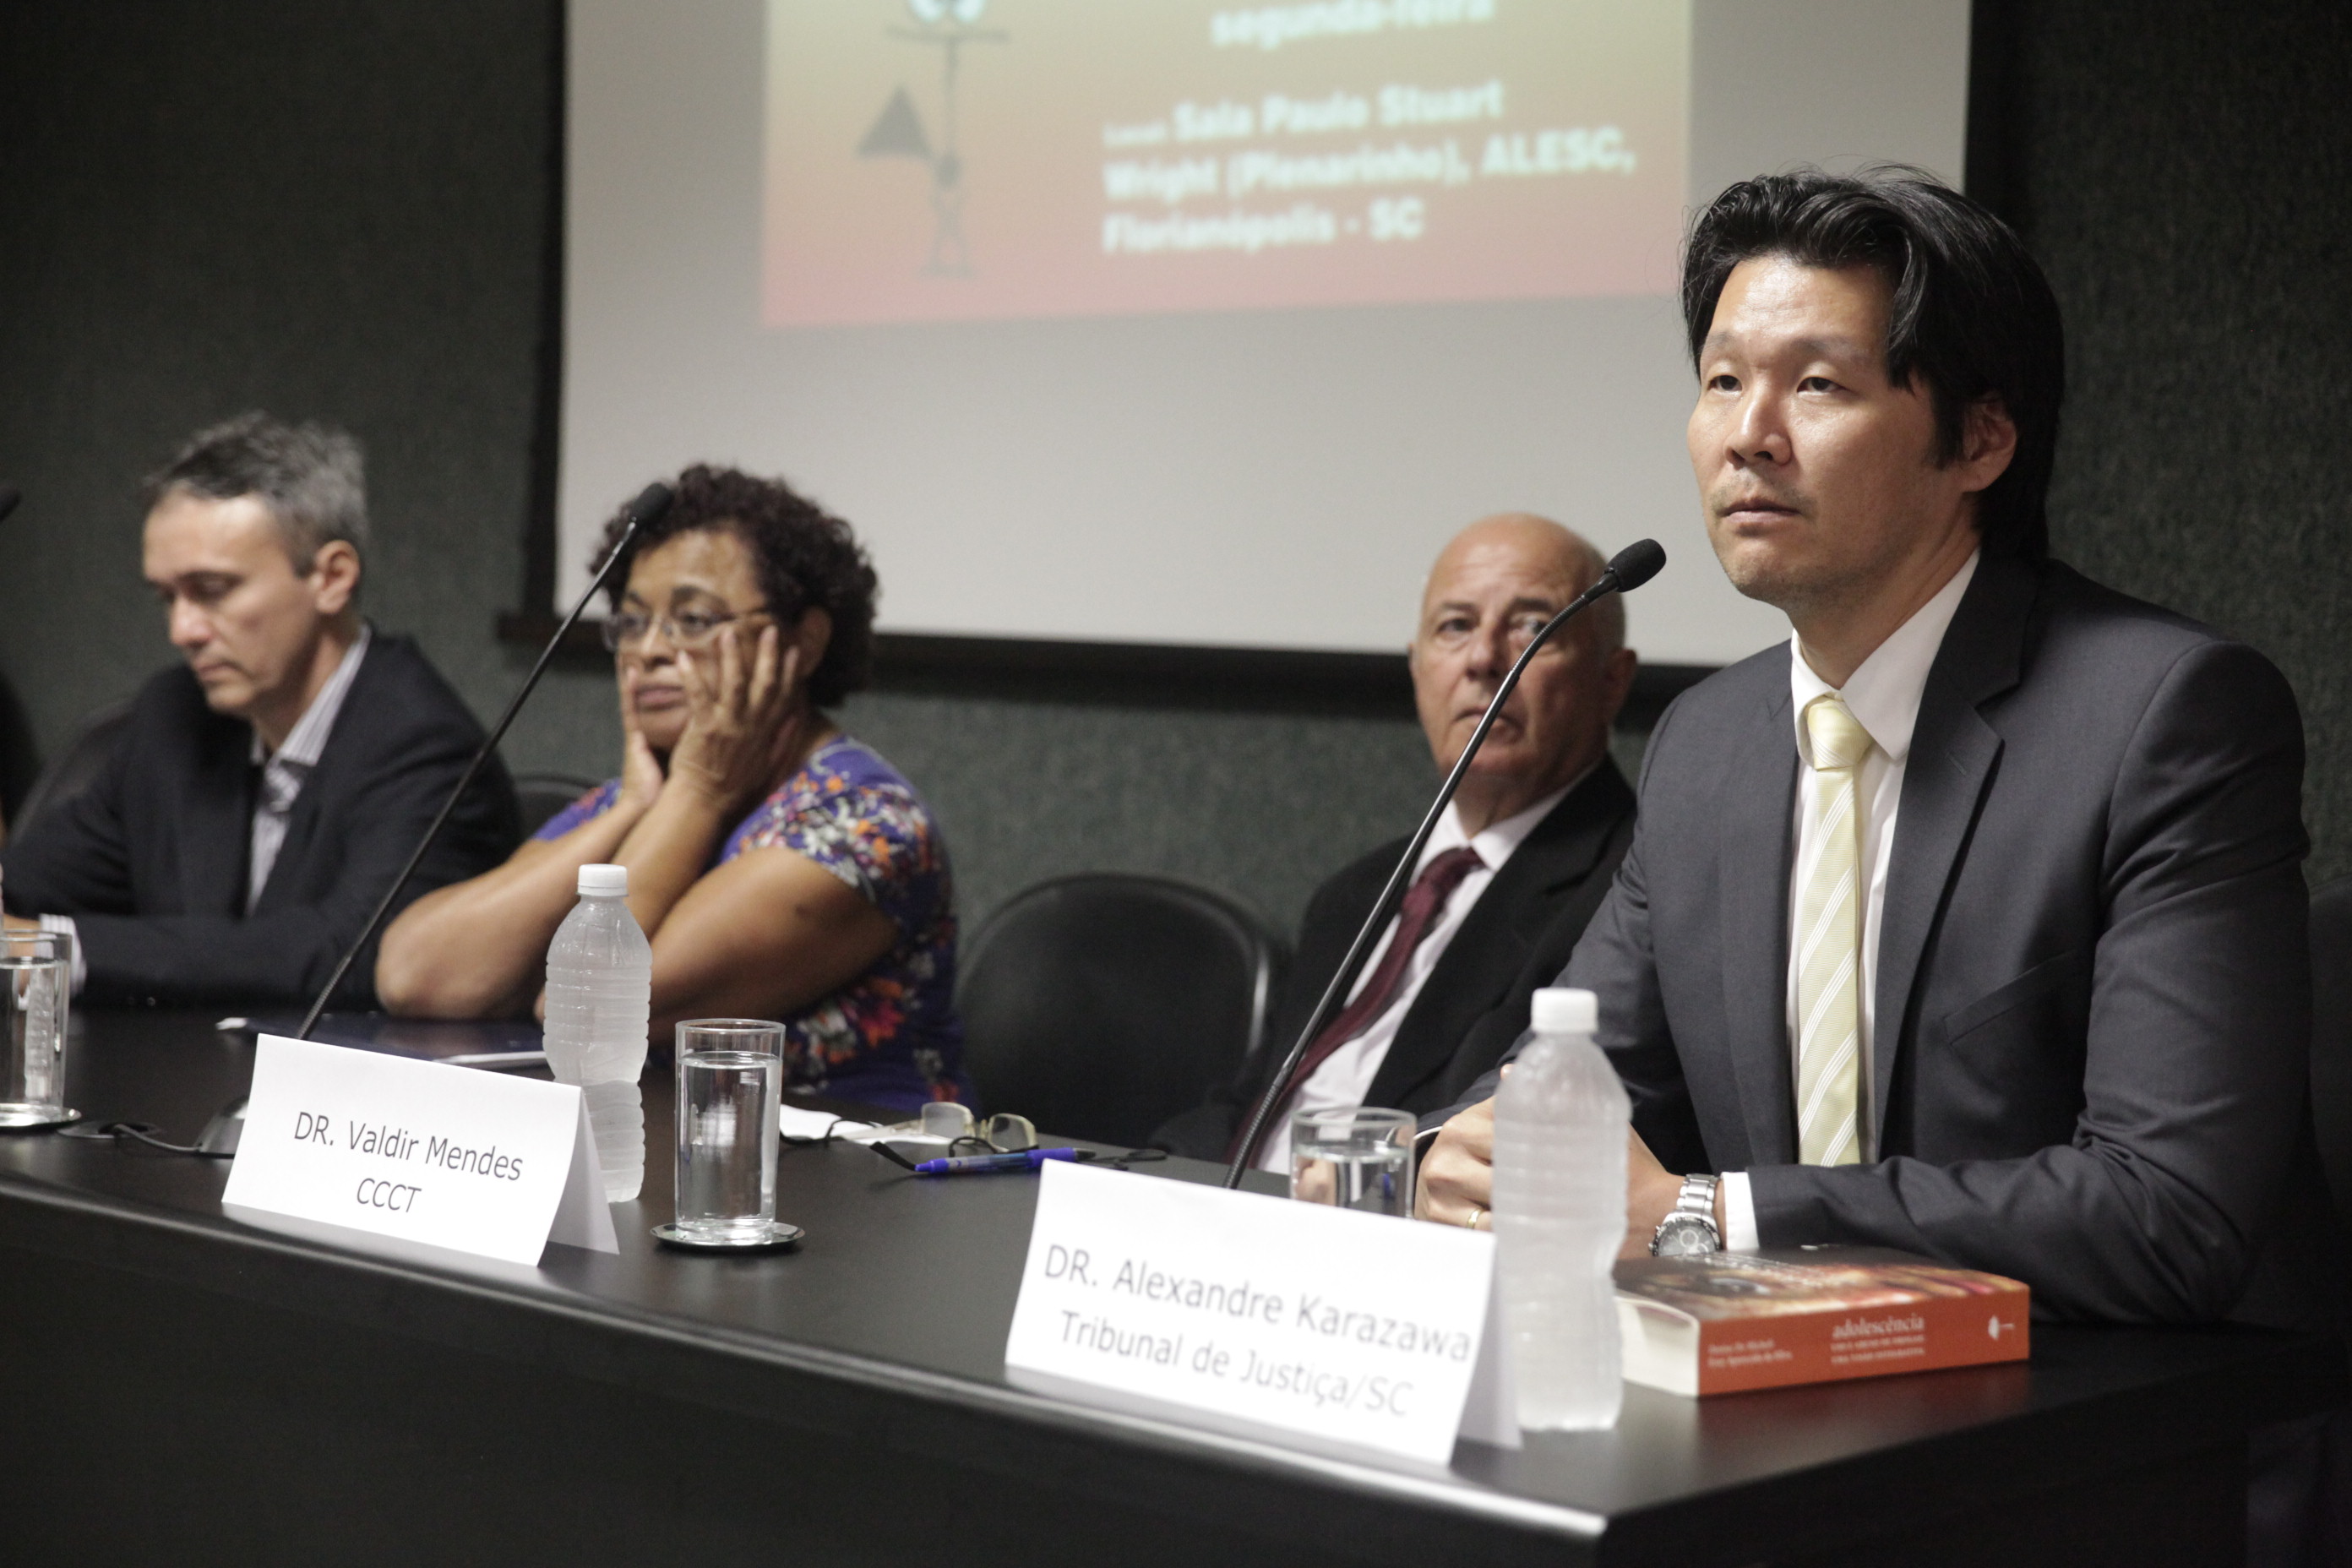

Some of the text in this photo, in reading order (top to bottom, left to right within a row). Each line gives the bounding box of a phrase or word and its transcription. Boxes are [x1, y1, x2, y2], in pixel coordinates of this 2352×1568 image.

[1175, 101, 1254, 142] Sala
[1262, 92, 1370, 134] Paulo
[1379, 79, 1505, 126] Stuart
[1103, 159, 1220, 203] Wright
[1368, 194, 1427, 241] SC
[293, 1112, 525, 1182] DR. Valdir Mendes
[356, 1177, 422, 1214] CCCT
[1044, 1244, 1473, 1364] DR. Alexandre Karazawa
[1832, 1313, 1926, 1340] adolescência
[1059, 1309, 1415, 1418] Tribunal de Justiça/SC
